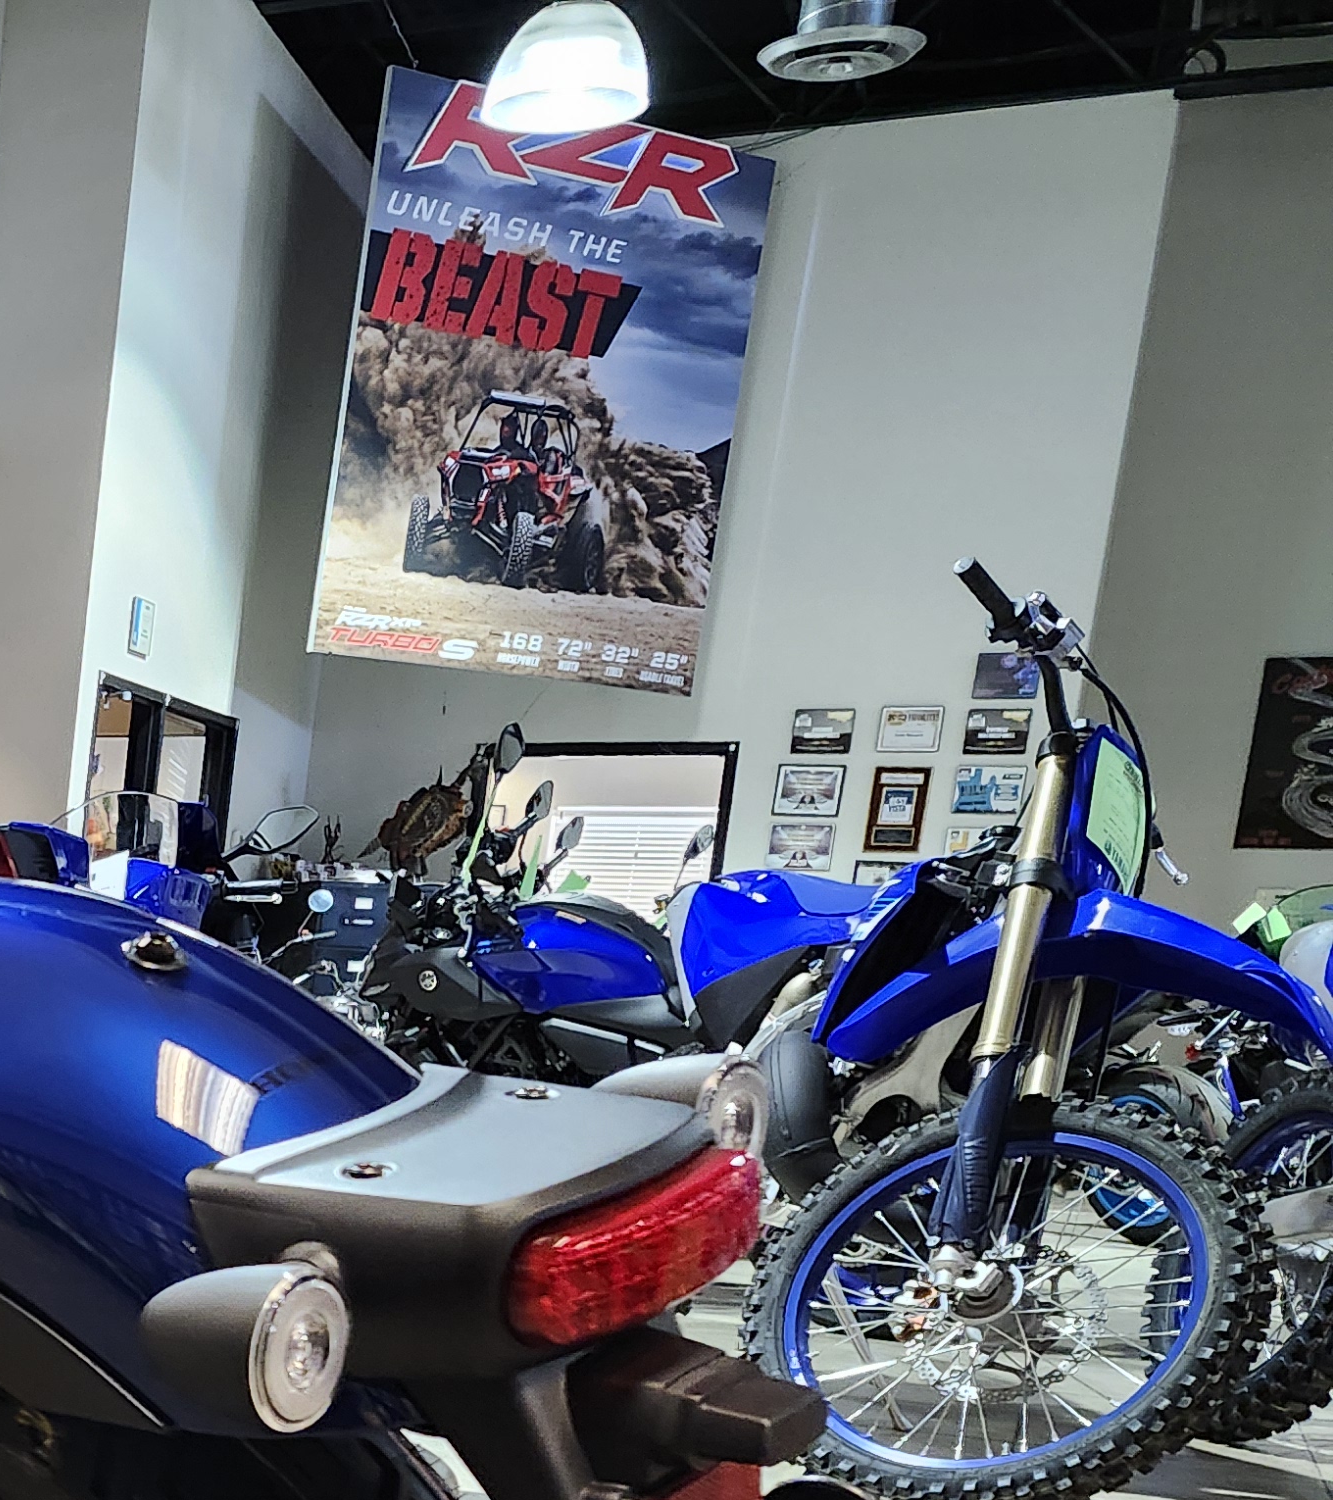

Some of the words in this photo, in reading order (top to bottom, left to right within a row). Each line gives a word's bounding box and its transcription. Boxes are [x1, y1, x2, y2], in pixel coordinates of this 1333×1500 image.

[386, 190, 550, 248] UNLEASH
[567, 229, 629, 263] THE
[370, 227, 623, 360] BEAST
[334, 610, 393, 631] RZR
[327, 625, 443, 654] TURBO
[438, 638, 480, 661] S
[499, 630, 543, 652] 168
[556, 637, 593, 657] 72"
[601, 644, 639, 664] 32"
[649, 651, 689, 671] 25"
